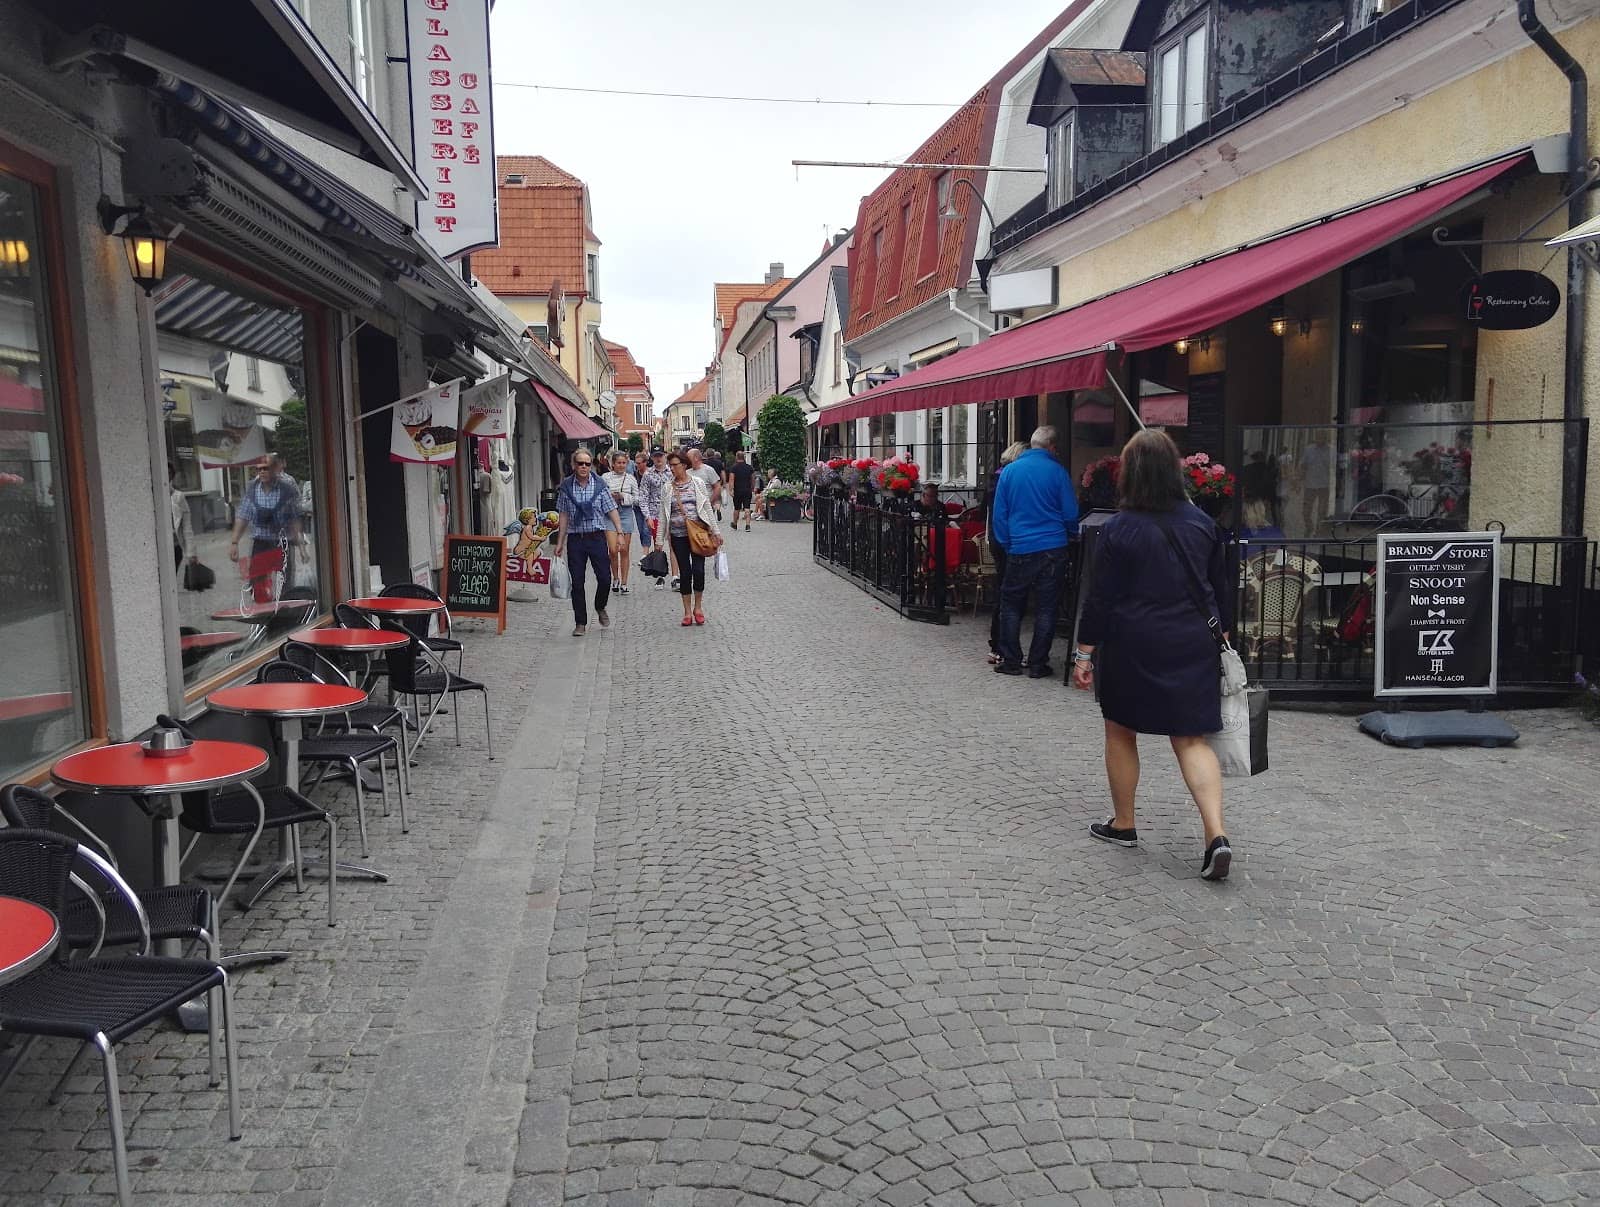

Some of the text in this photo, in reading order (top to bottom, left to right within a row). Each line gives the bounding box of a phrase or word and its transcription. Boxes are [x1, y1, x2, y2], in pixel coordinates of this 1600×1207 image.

[424, 0, 457, 232] GLASSERIET
[1486, 296, 1527, 308] Restaurang
[1388, 545, 1489, 559] BRANDS STORE
[506, 558, 545, 576] SIA
[1442, 563, 1466, 571] VISBY
[459, 574, 490, 594] GLASS
[1409, 578, 1466, 588] SNOOT
[1410, 594, 1466, 606] Non Sense
